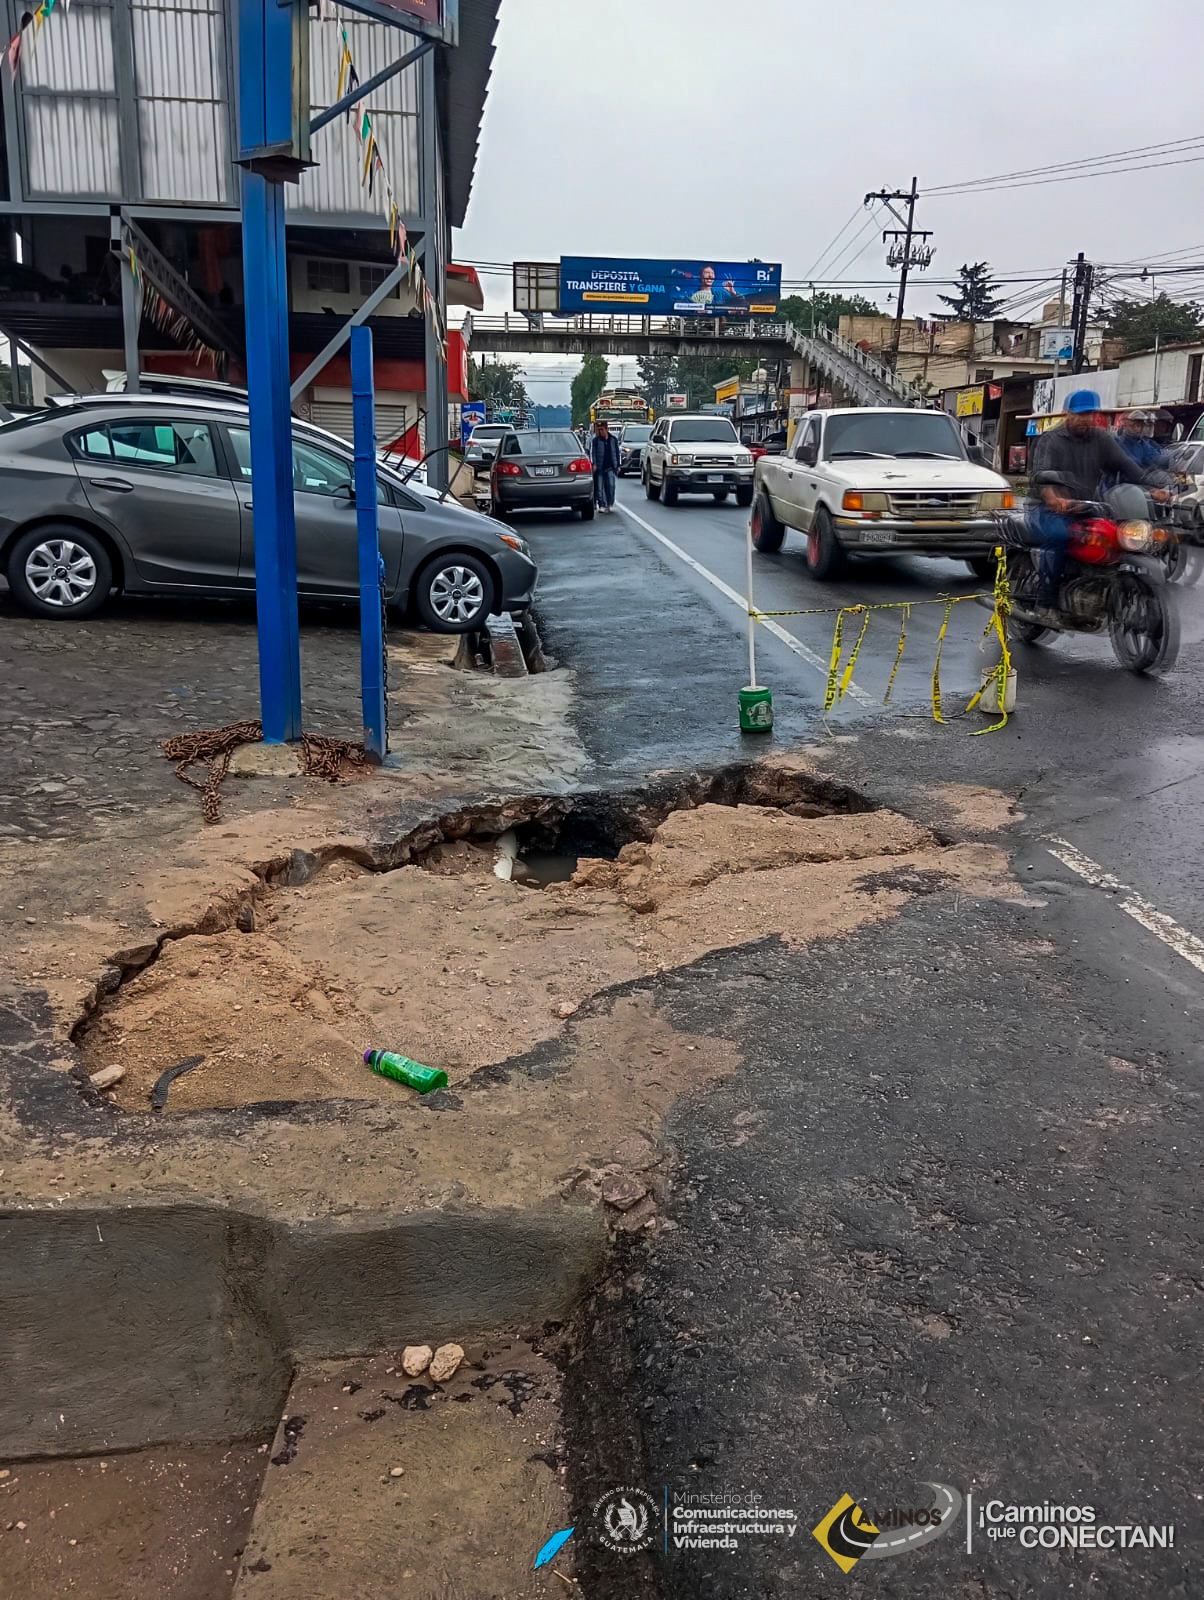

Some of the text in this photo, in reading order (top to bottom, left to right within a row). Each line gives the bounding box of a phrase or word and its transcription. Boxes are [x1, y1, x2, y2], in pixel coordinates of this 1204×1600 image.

[756, 266, 774, 281] Bi
[566, 280, 666, 293] TRANSFIERE Y GANA
